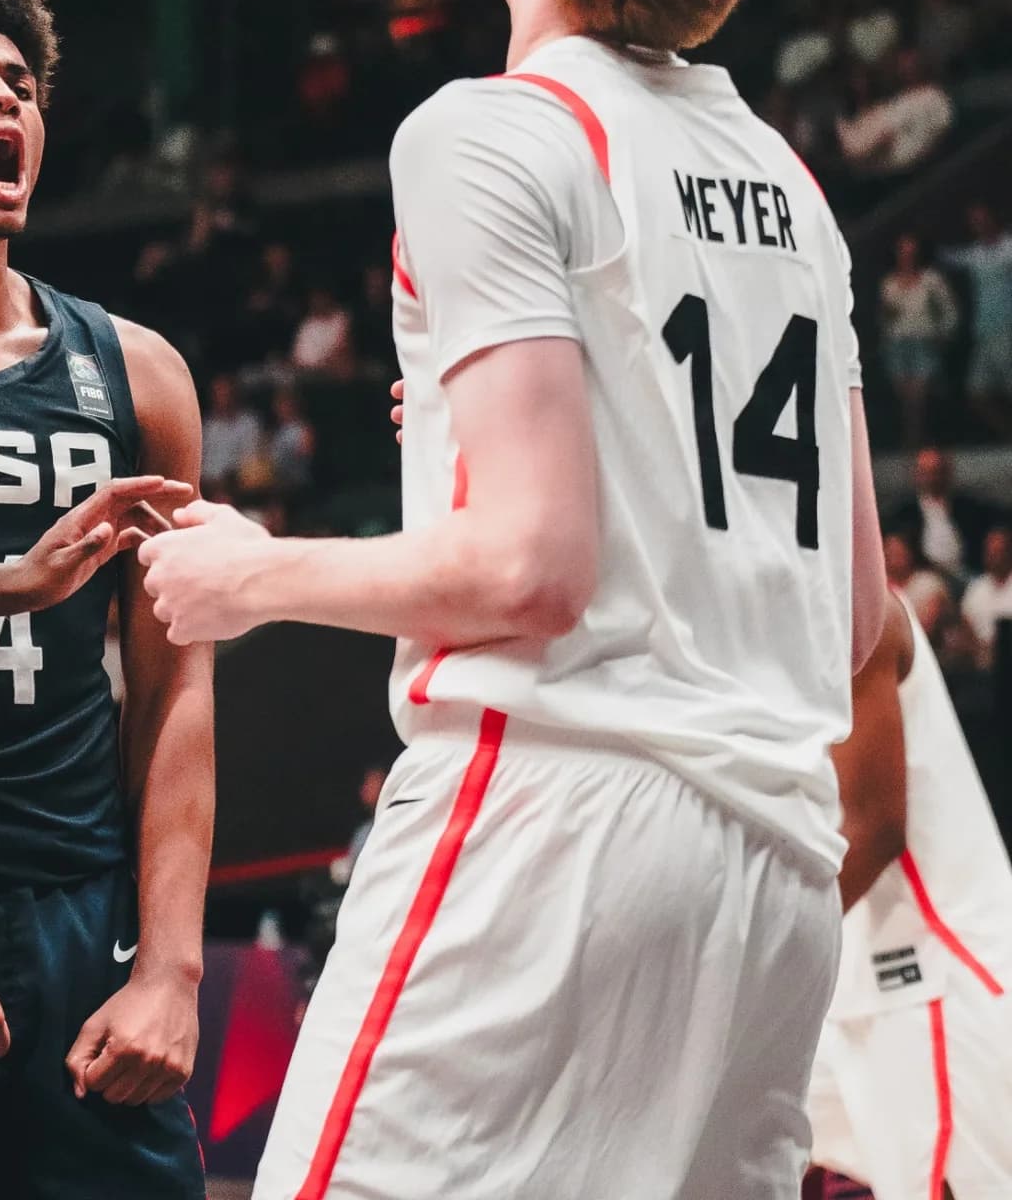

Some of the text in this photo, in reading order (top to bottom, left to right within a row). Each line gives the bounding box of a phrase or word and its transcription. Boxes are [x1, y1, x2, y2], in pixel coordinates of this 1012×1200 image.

[673, 169, 797, 252] MEYER
[80, 385, 104, 401] FIBA
[662, 293, 819, 551] 14
